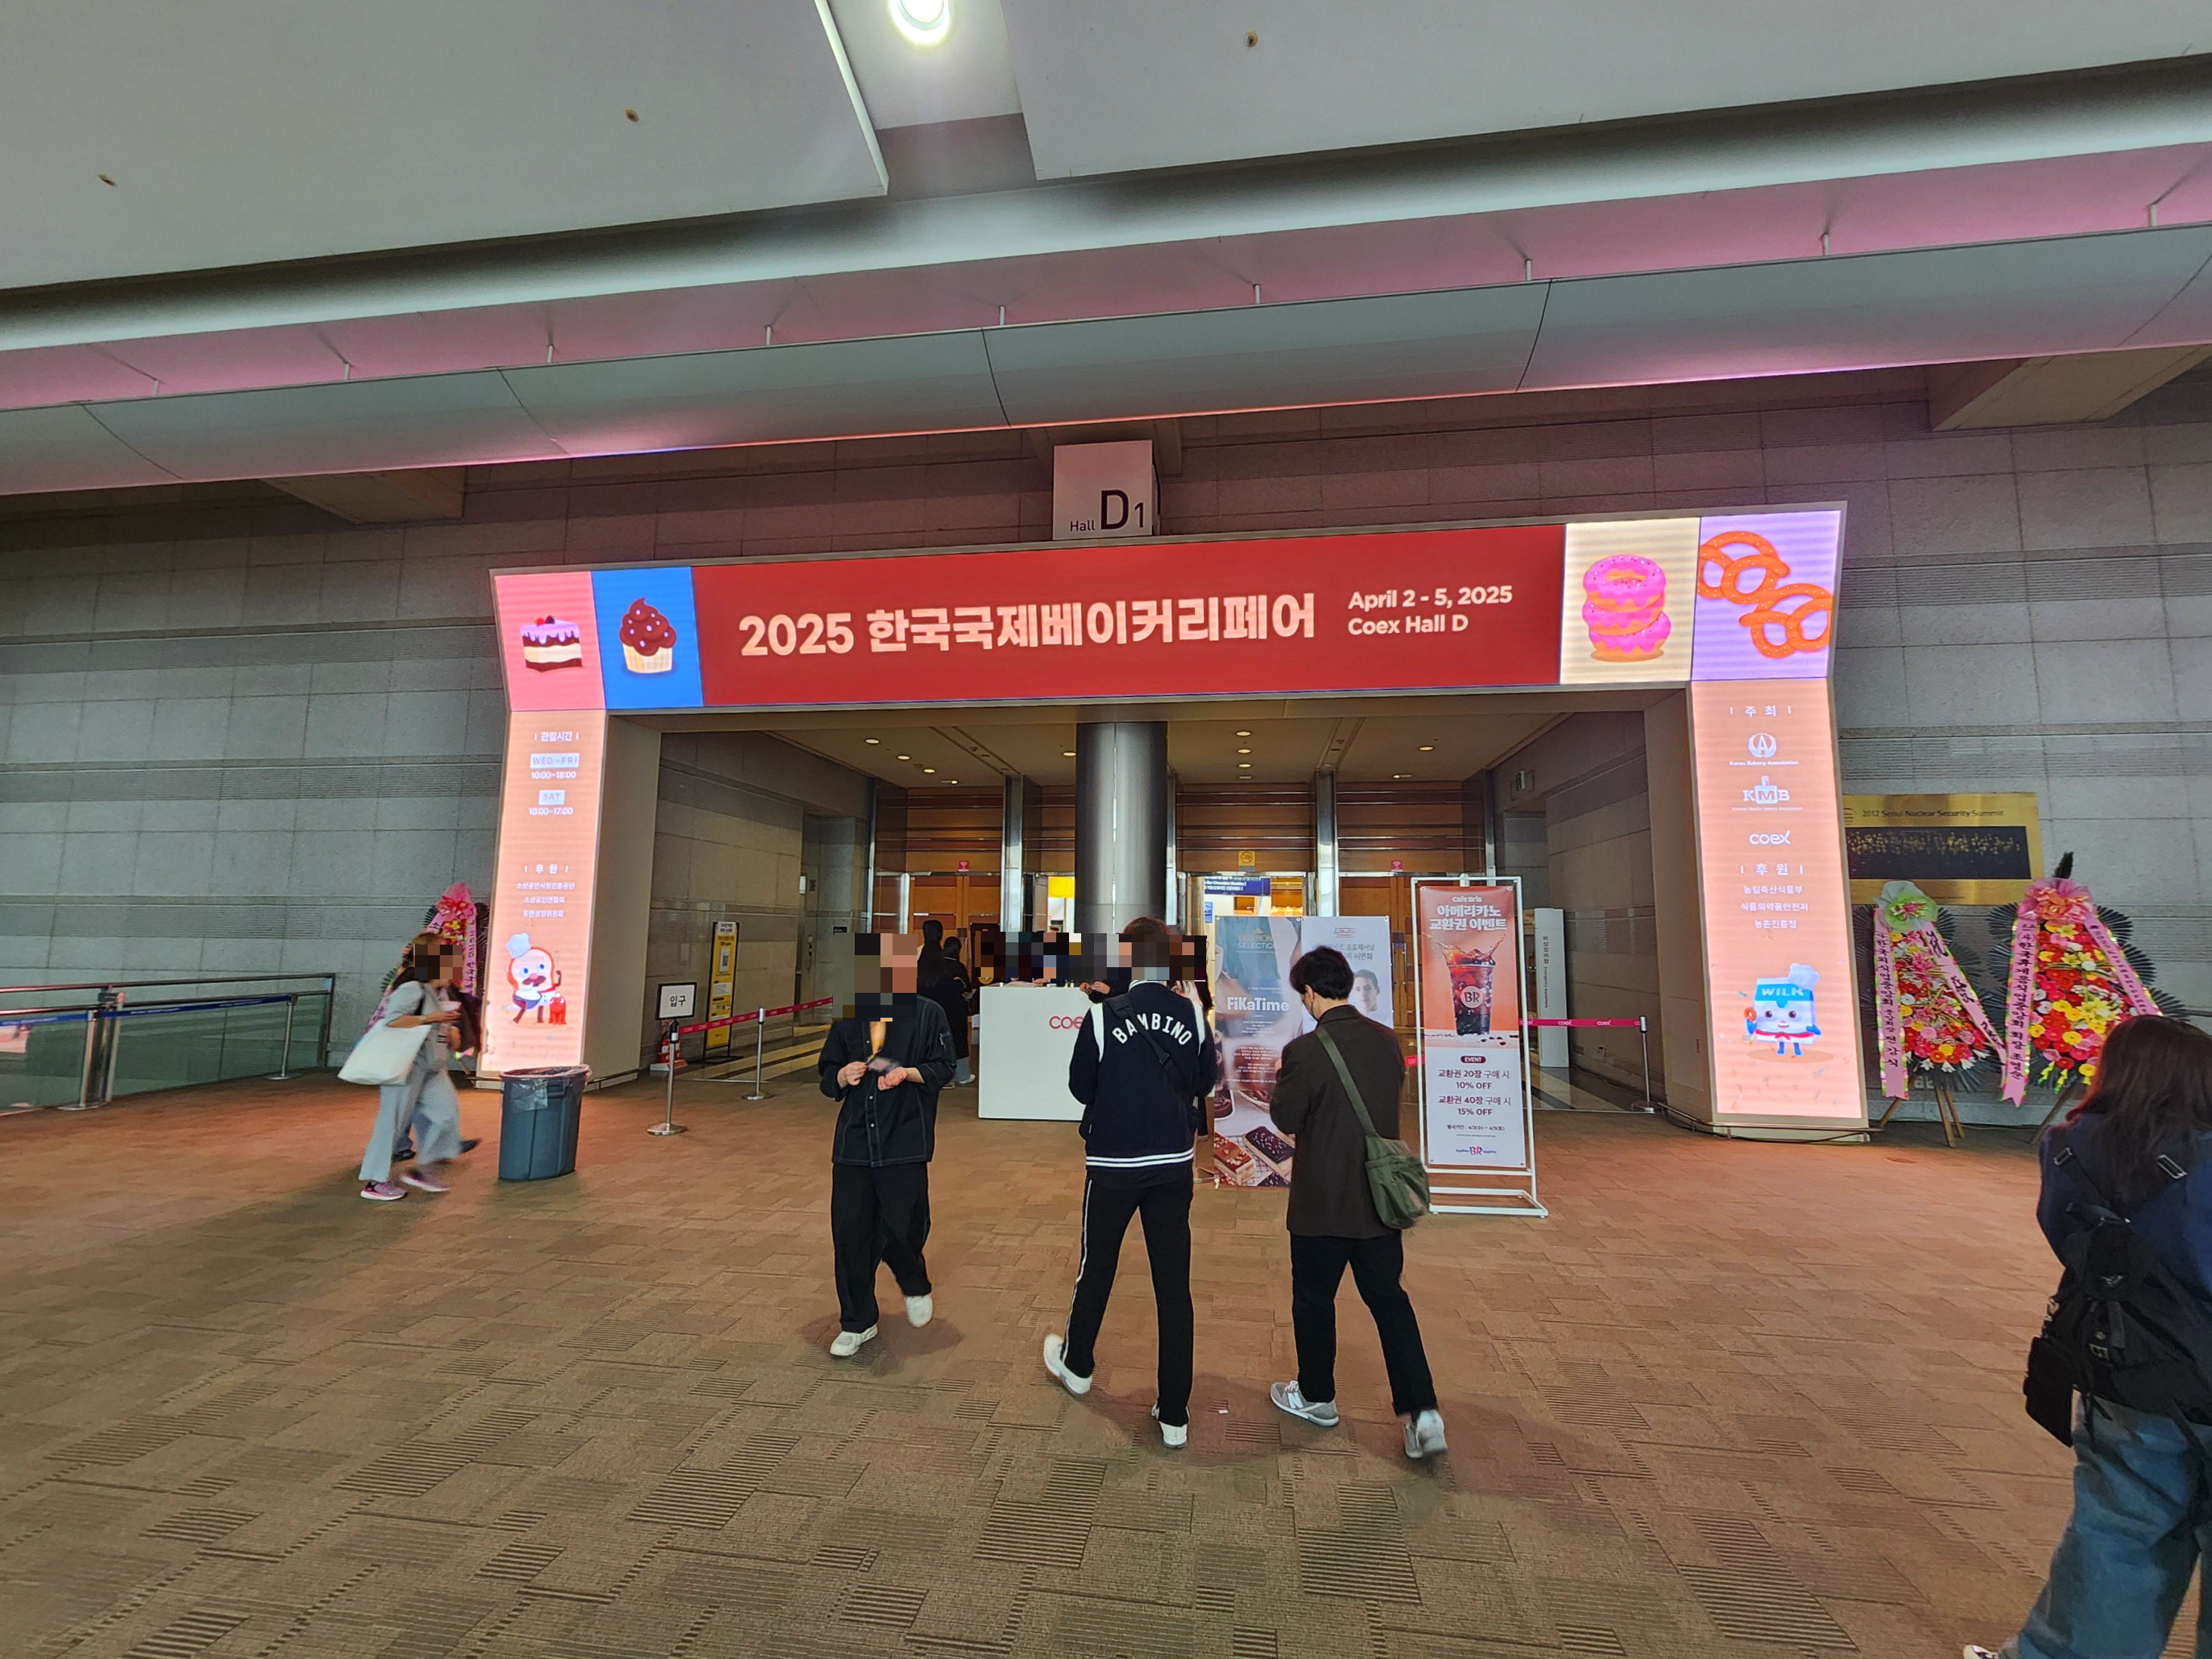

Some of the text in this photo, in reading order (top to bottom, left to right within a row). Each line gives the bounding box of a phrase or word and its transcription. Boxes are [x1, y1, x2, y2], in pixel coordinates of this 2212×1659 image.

[1070, 520, 1095, 532] Hall
[1347, 589, 1397, 612] April
[1402, 589, 1416, 607] 2
[1433, 588, 1453, 609] 5,
[1457, 585, 1513, 605] 2025
[739, 593, 1316, 656] 2025 한국국제베이커리페어
[1347, 614, 1469, 635] Coex Hall D
[1743, 789, 1790, 802] KMB
[1937, 810, 1970, 818] Security
[1749, 830, 1790, 845] coex
[1743, 885, 1802, 894] 농림축산식품부
[1436, 905, 1501, 917] 아메리카노
[1740, 902, 1808, 911] 식품의약품안전처
[1429, 918, 1507, 930] 교환권 이벤트
[1755, 920, 1797, 929] 농촌진흥청
[670, 995, 686, 1007] 입구
[1227, 997, 1290, 1011] FiKaTime
[1049, 1015, 1083, 1029] coe
[1438, 1070, 1461, 1078] 교환권
[1484, 1071, 1500, 1079] 구매
[1502, 1071, 1510, 1079] 시
[1438, 1096, 1511, 1105] 교환권 40장 구매 시
